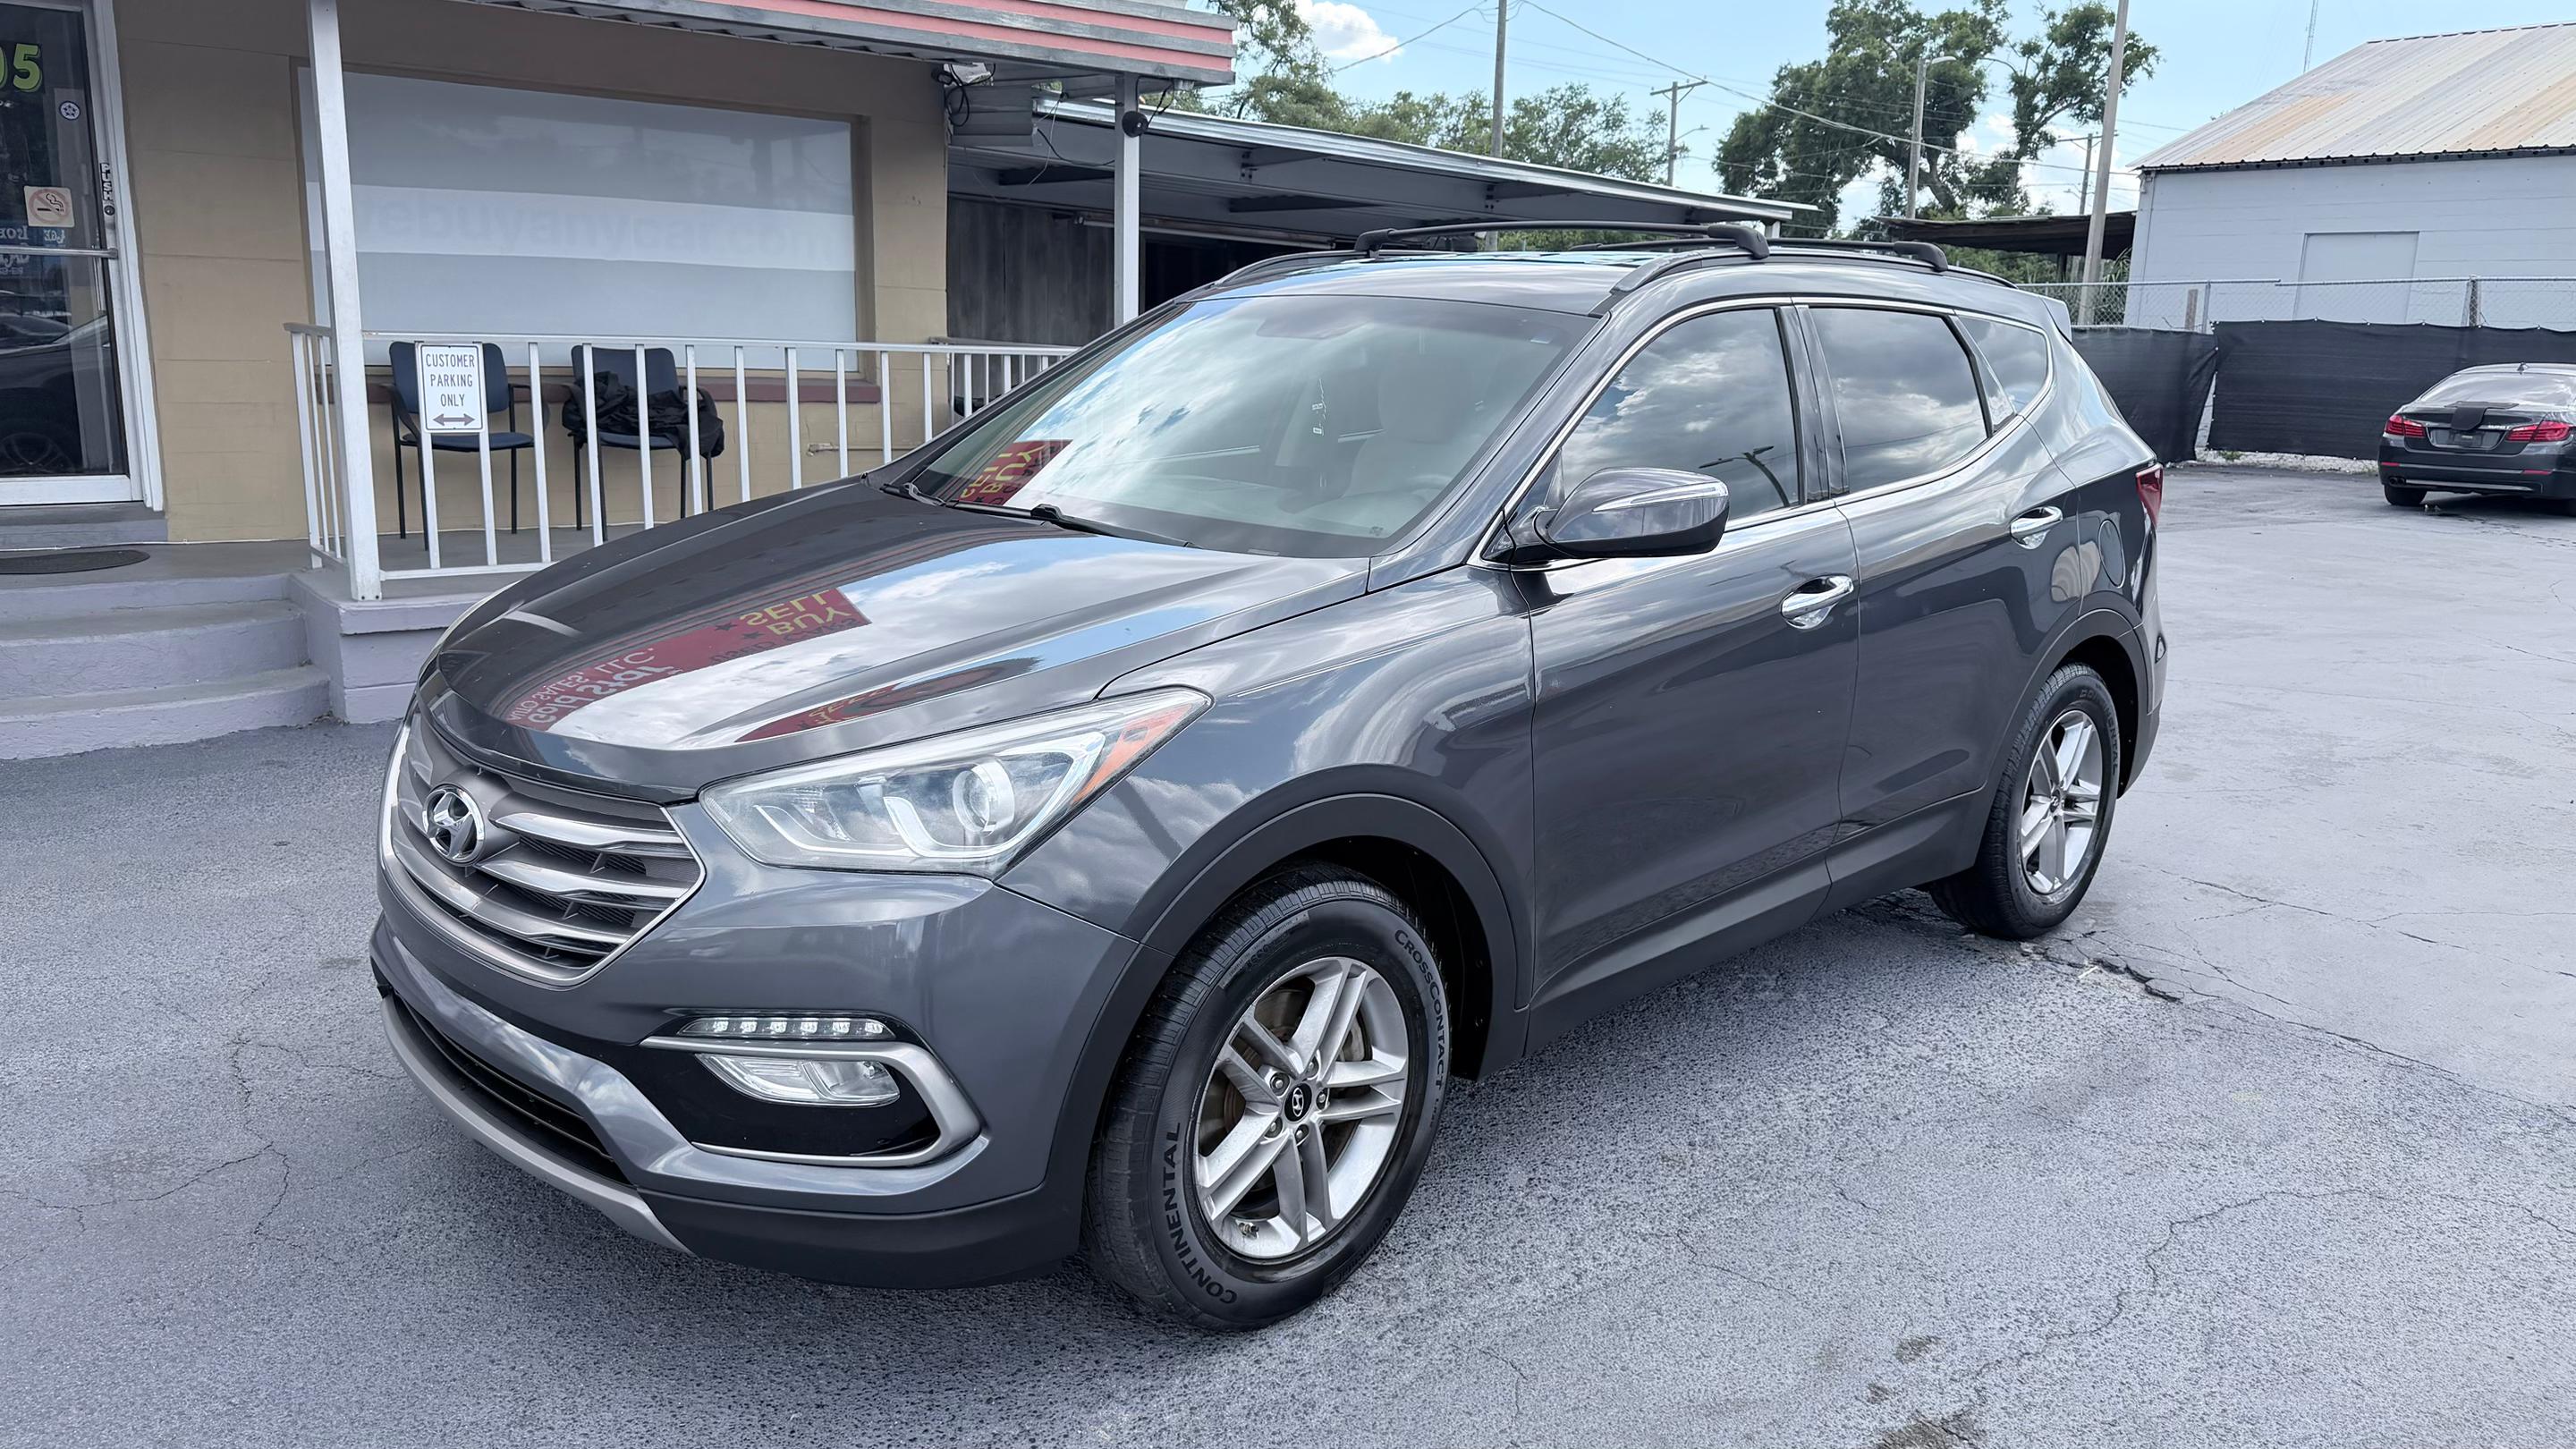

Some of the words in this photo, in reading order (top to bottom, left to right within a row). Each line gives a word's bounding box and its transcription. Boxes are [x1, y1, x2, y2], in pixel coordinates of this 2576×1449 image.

[101, 164, 113, 200] PUSH
[426, 353, 475, 368] CUSTOMER
[430, 374, 473, 386] PARKING
[440, 394, 465, 407] ONLY
[1394, 928, 1445, 1090] CROSSCONTACT
[1163, 1123, 1238, 1304] CONTINENTAL
